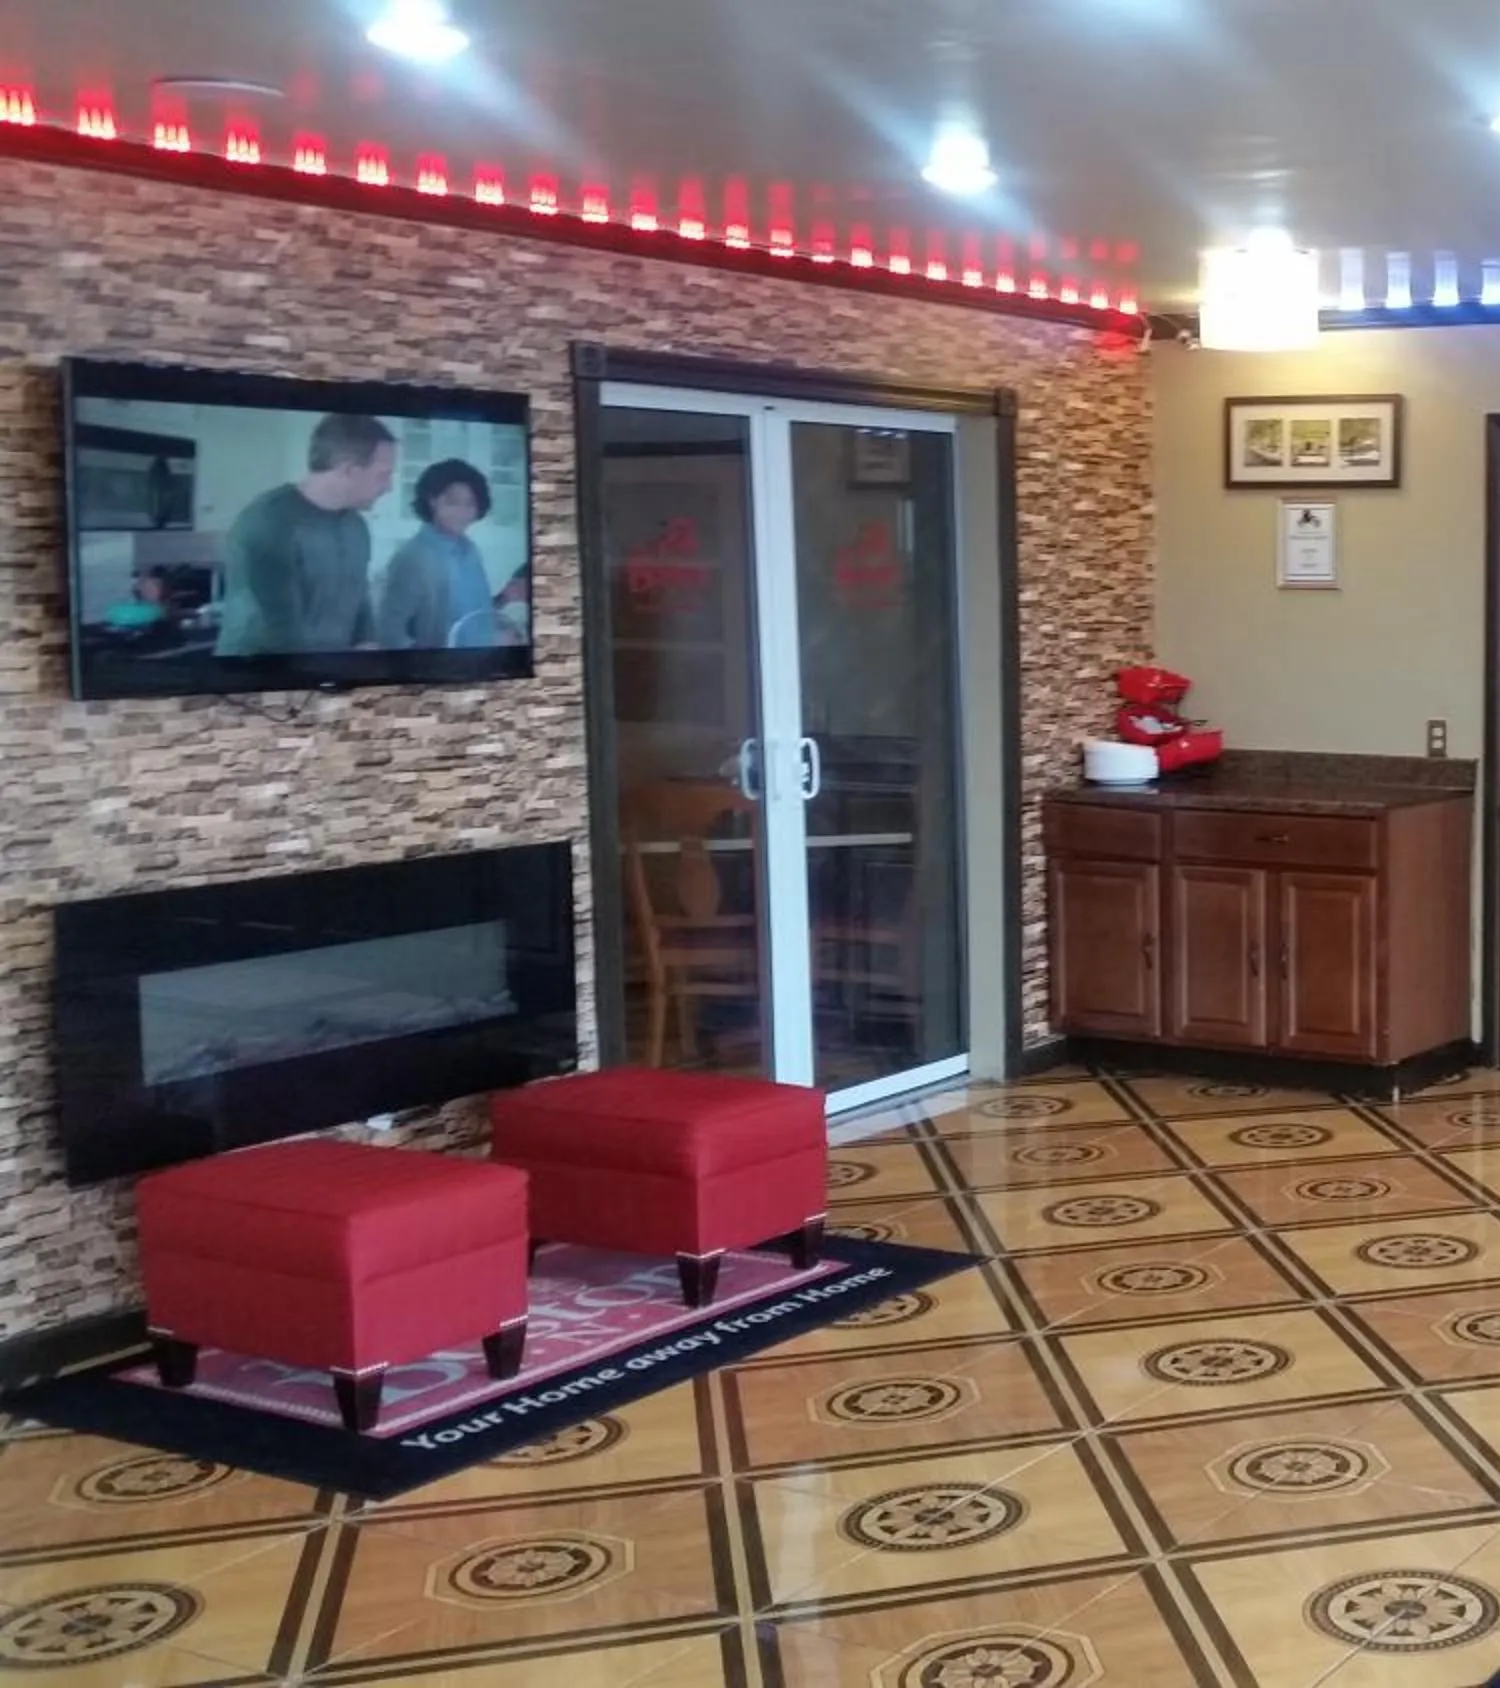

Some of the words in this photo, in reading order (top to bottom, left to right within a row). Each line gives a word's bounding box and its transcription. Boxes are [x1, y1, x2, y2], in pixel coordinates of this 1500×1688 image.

[400, 1410, 504, 1450] Your
[502, 1367, 627, 1415] Home
[625, 1329, 721, 1370] away
[714, 1299, 802, 1334] from
[795, 1265, 894, 1304] Home
